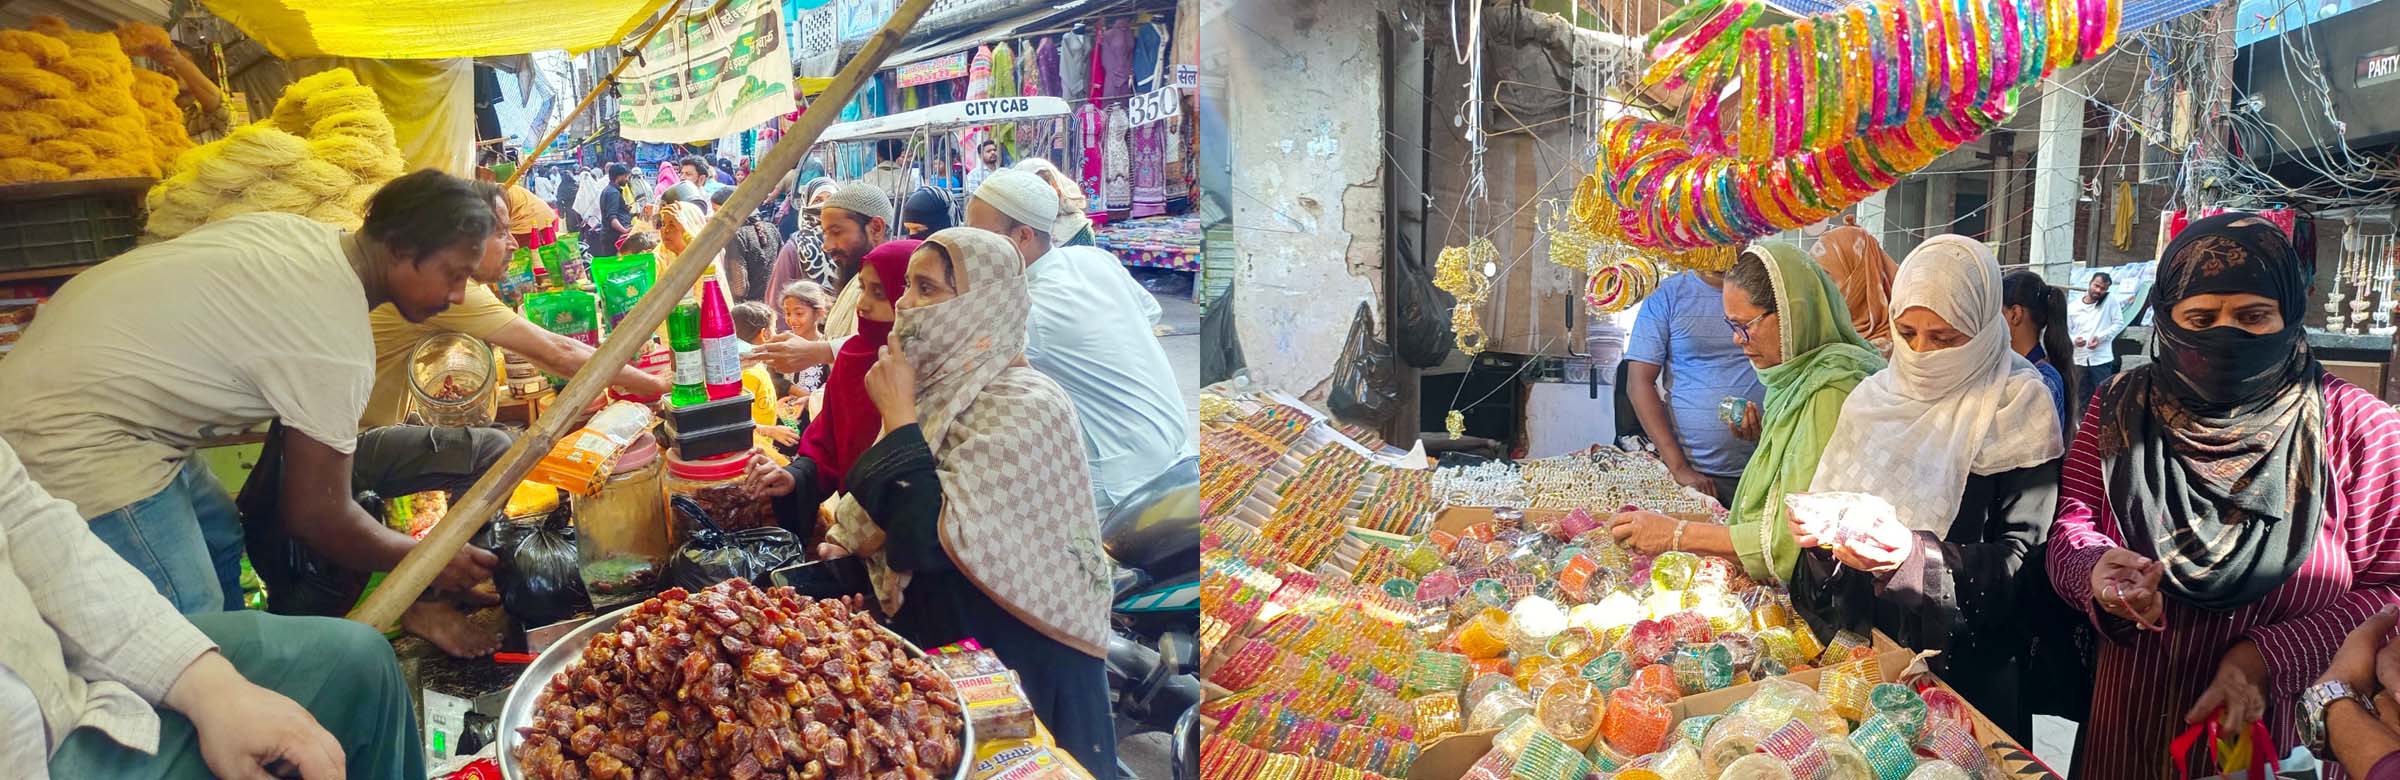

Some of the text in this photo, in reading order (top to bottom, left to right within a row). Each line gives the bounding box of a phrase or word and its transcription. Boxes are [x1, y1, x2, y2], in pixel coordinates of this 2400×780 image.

[1177, 65, 1197, 85] सेल
[2367, 54, 2400, 79] PARTY
[965, 98, 1029, 116] CITY CAB
[1131, 86, 1178, 126] 350
